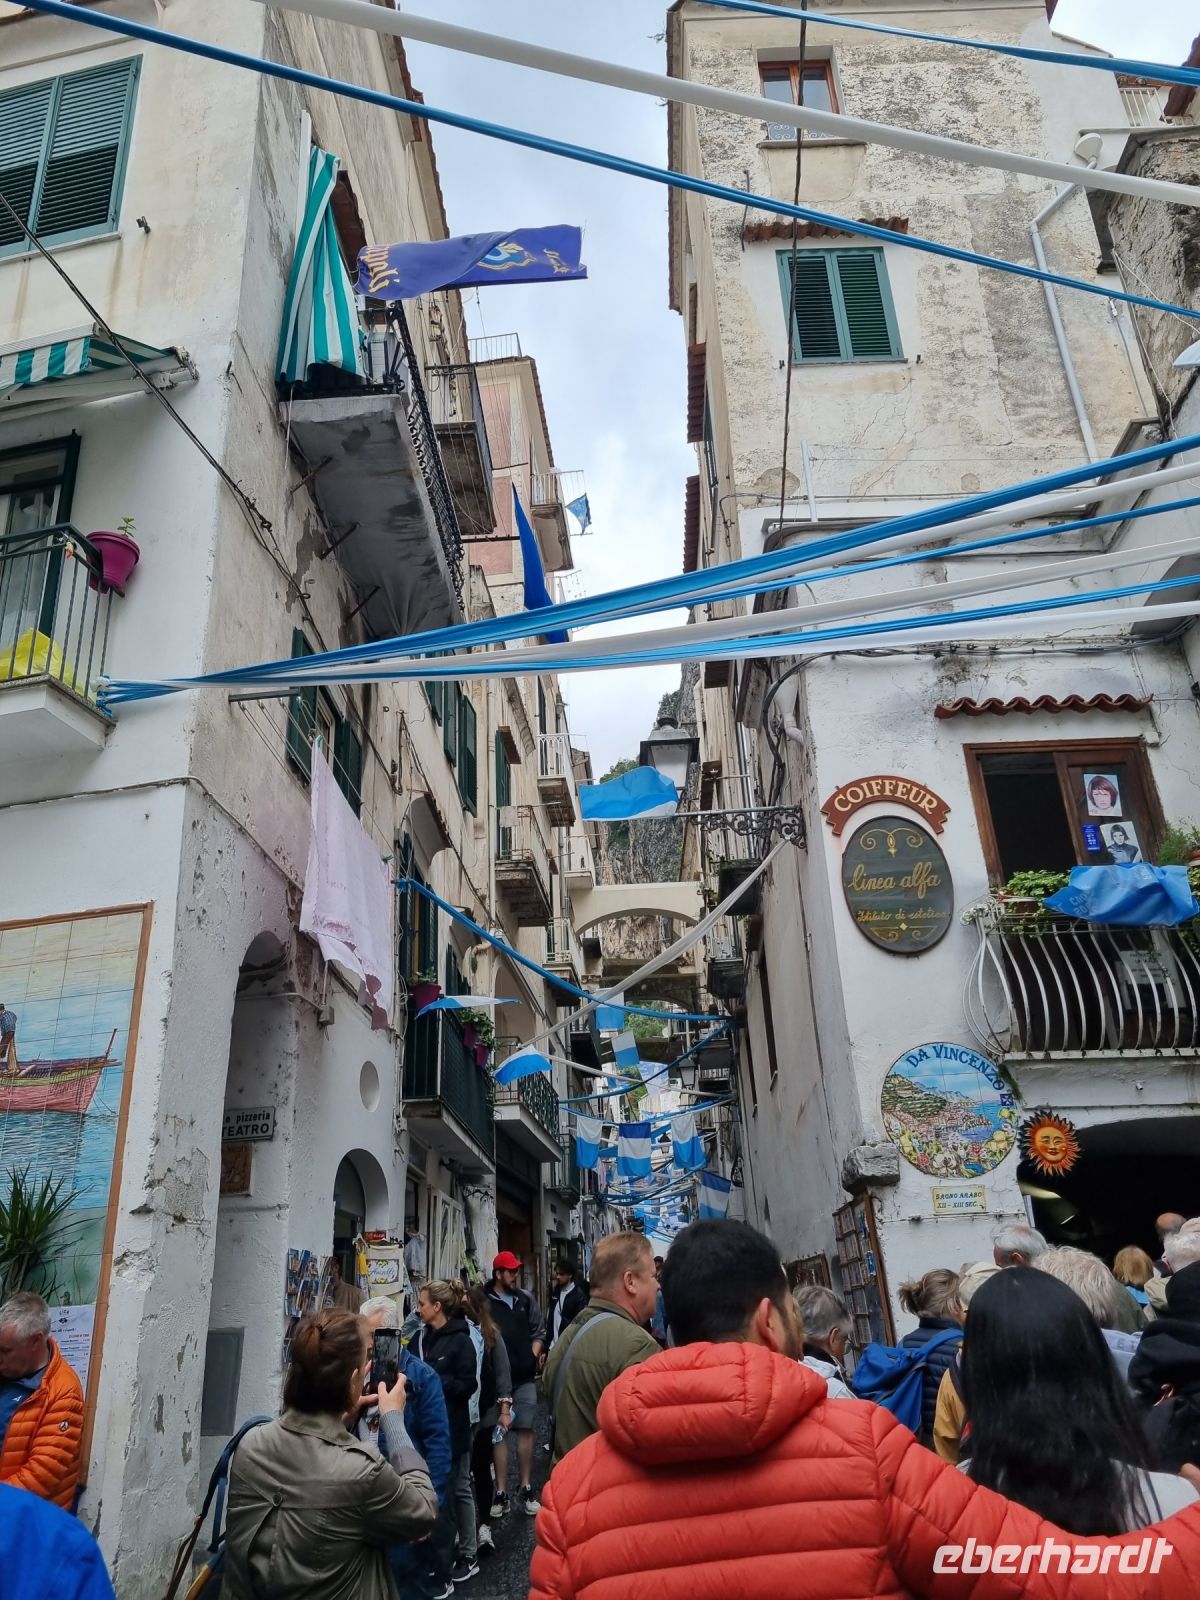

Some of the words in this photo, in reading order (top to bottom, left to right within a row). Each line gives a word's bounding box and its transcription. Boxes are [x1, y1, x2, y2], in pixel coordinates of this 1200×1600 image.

[834, 779, 938, 815] COIFFEUR
[848, 863, 896, 891] linea
[899, 862, 942, 899] alfa
[895, 908, 906, 920] di
[906, 1048, 931, 1068] DA
[933, 1044, 1005, 1091] VINCENZO
[236, 1110, 271, 1124] pizzeria
[960, 1191, 983, 1199] ARABO
